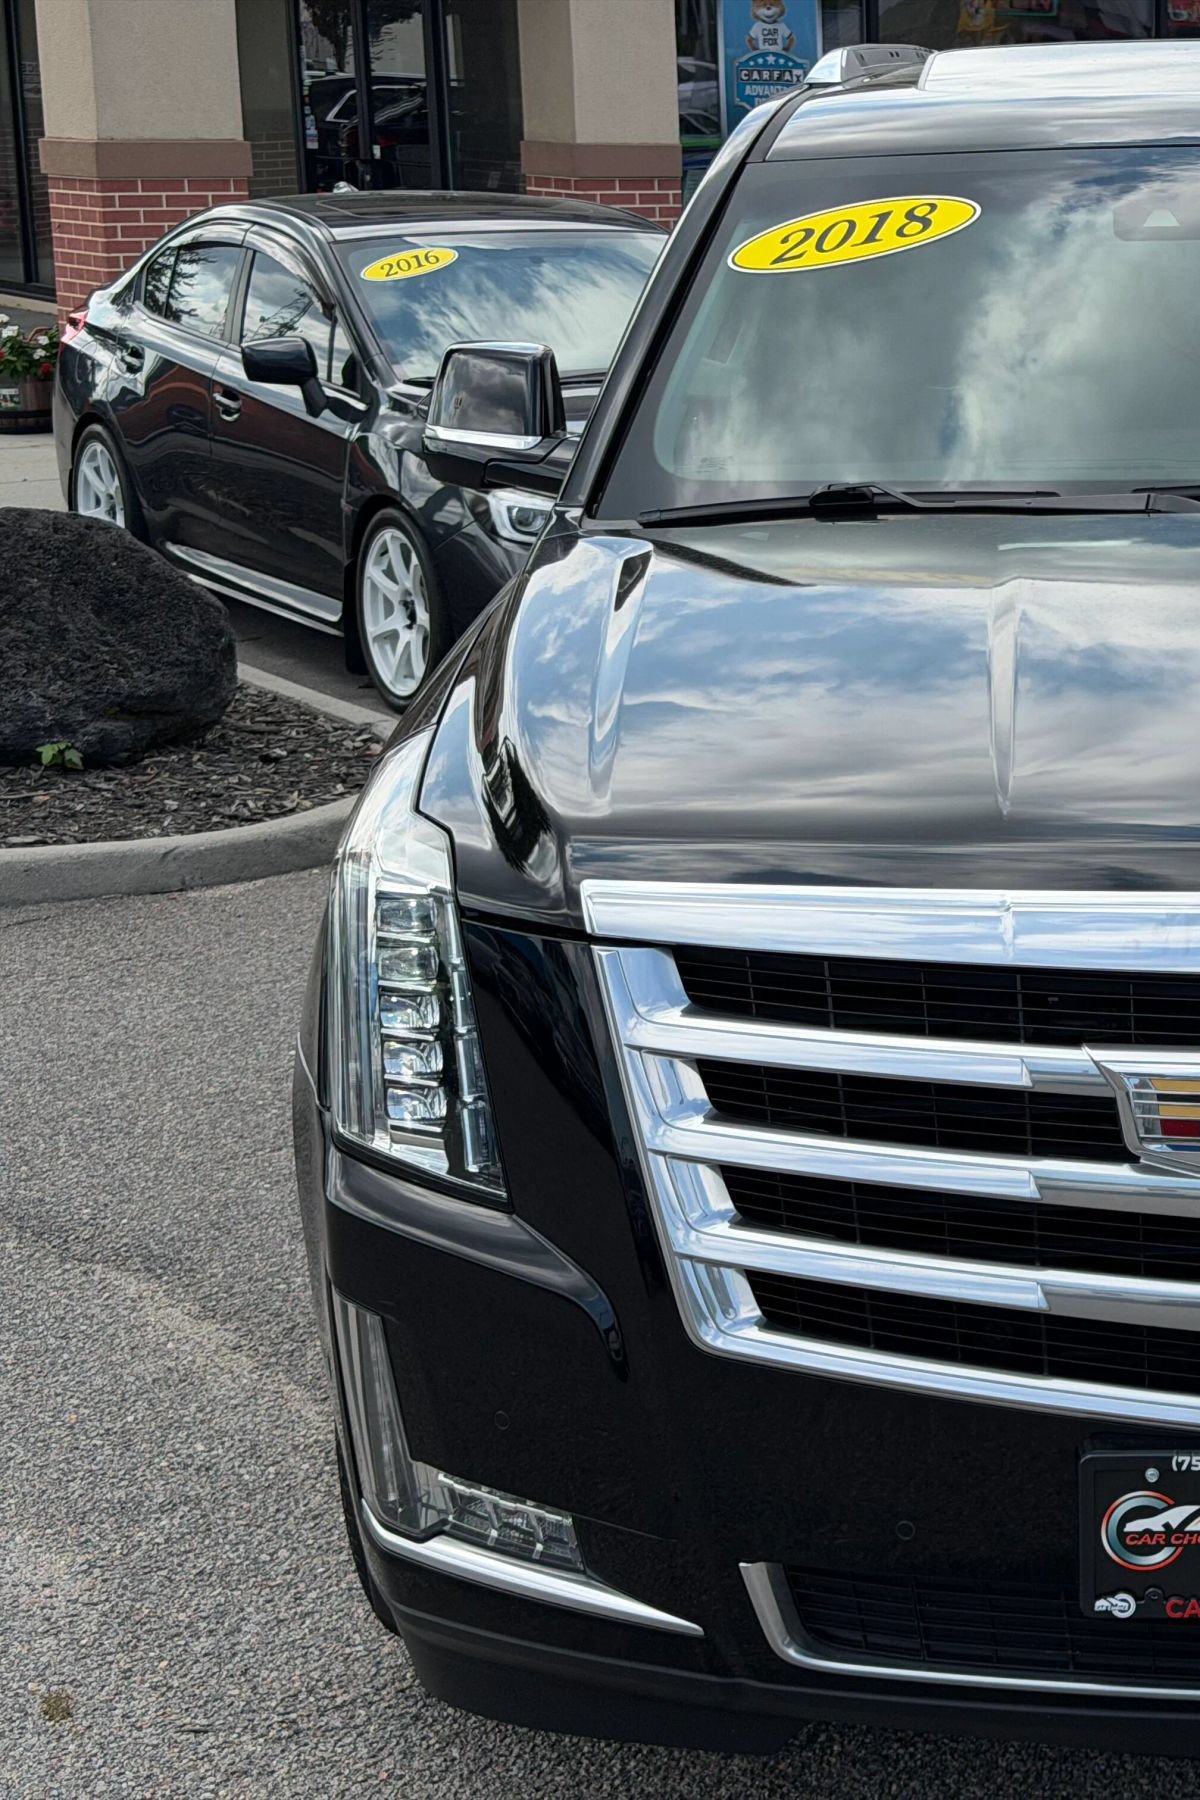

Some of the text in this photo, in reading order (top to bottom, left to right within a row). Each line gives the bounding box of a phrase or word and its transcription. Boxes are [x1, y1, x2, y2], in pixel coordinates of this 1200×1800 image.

[761, 28, 779, 37] CAR
[762, 38, 779, 47] FOX
[740, 70, 804, 83] CARFAX
[769, 202, 938, 266] 2018
[380, 249, 440, 277] 2016
[1125, 1533, 1168, 1546] CAR
